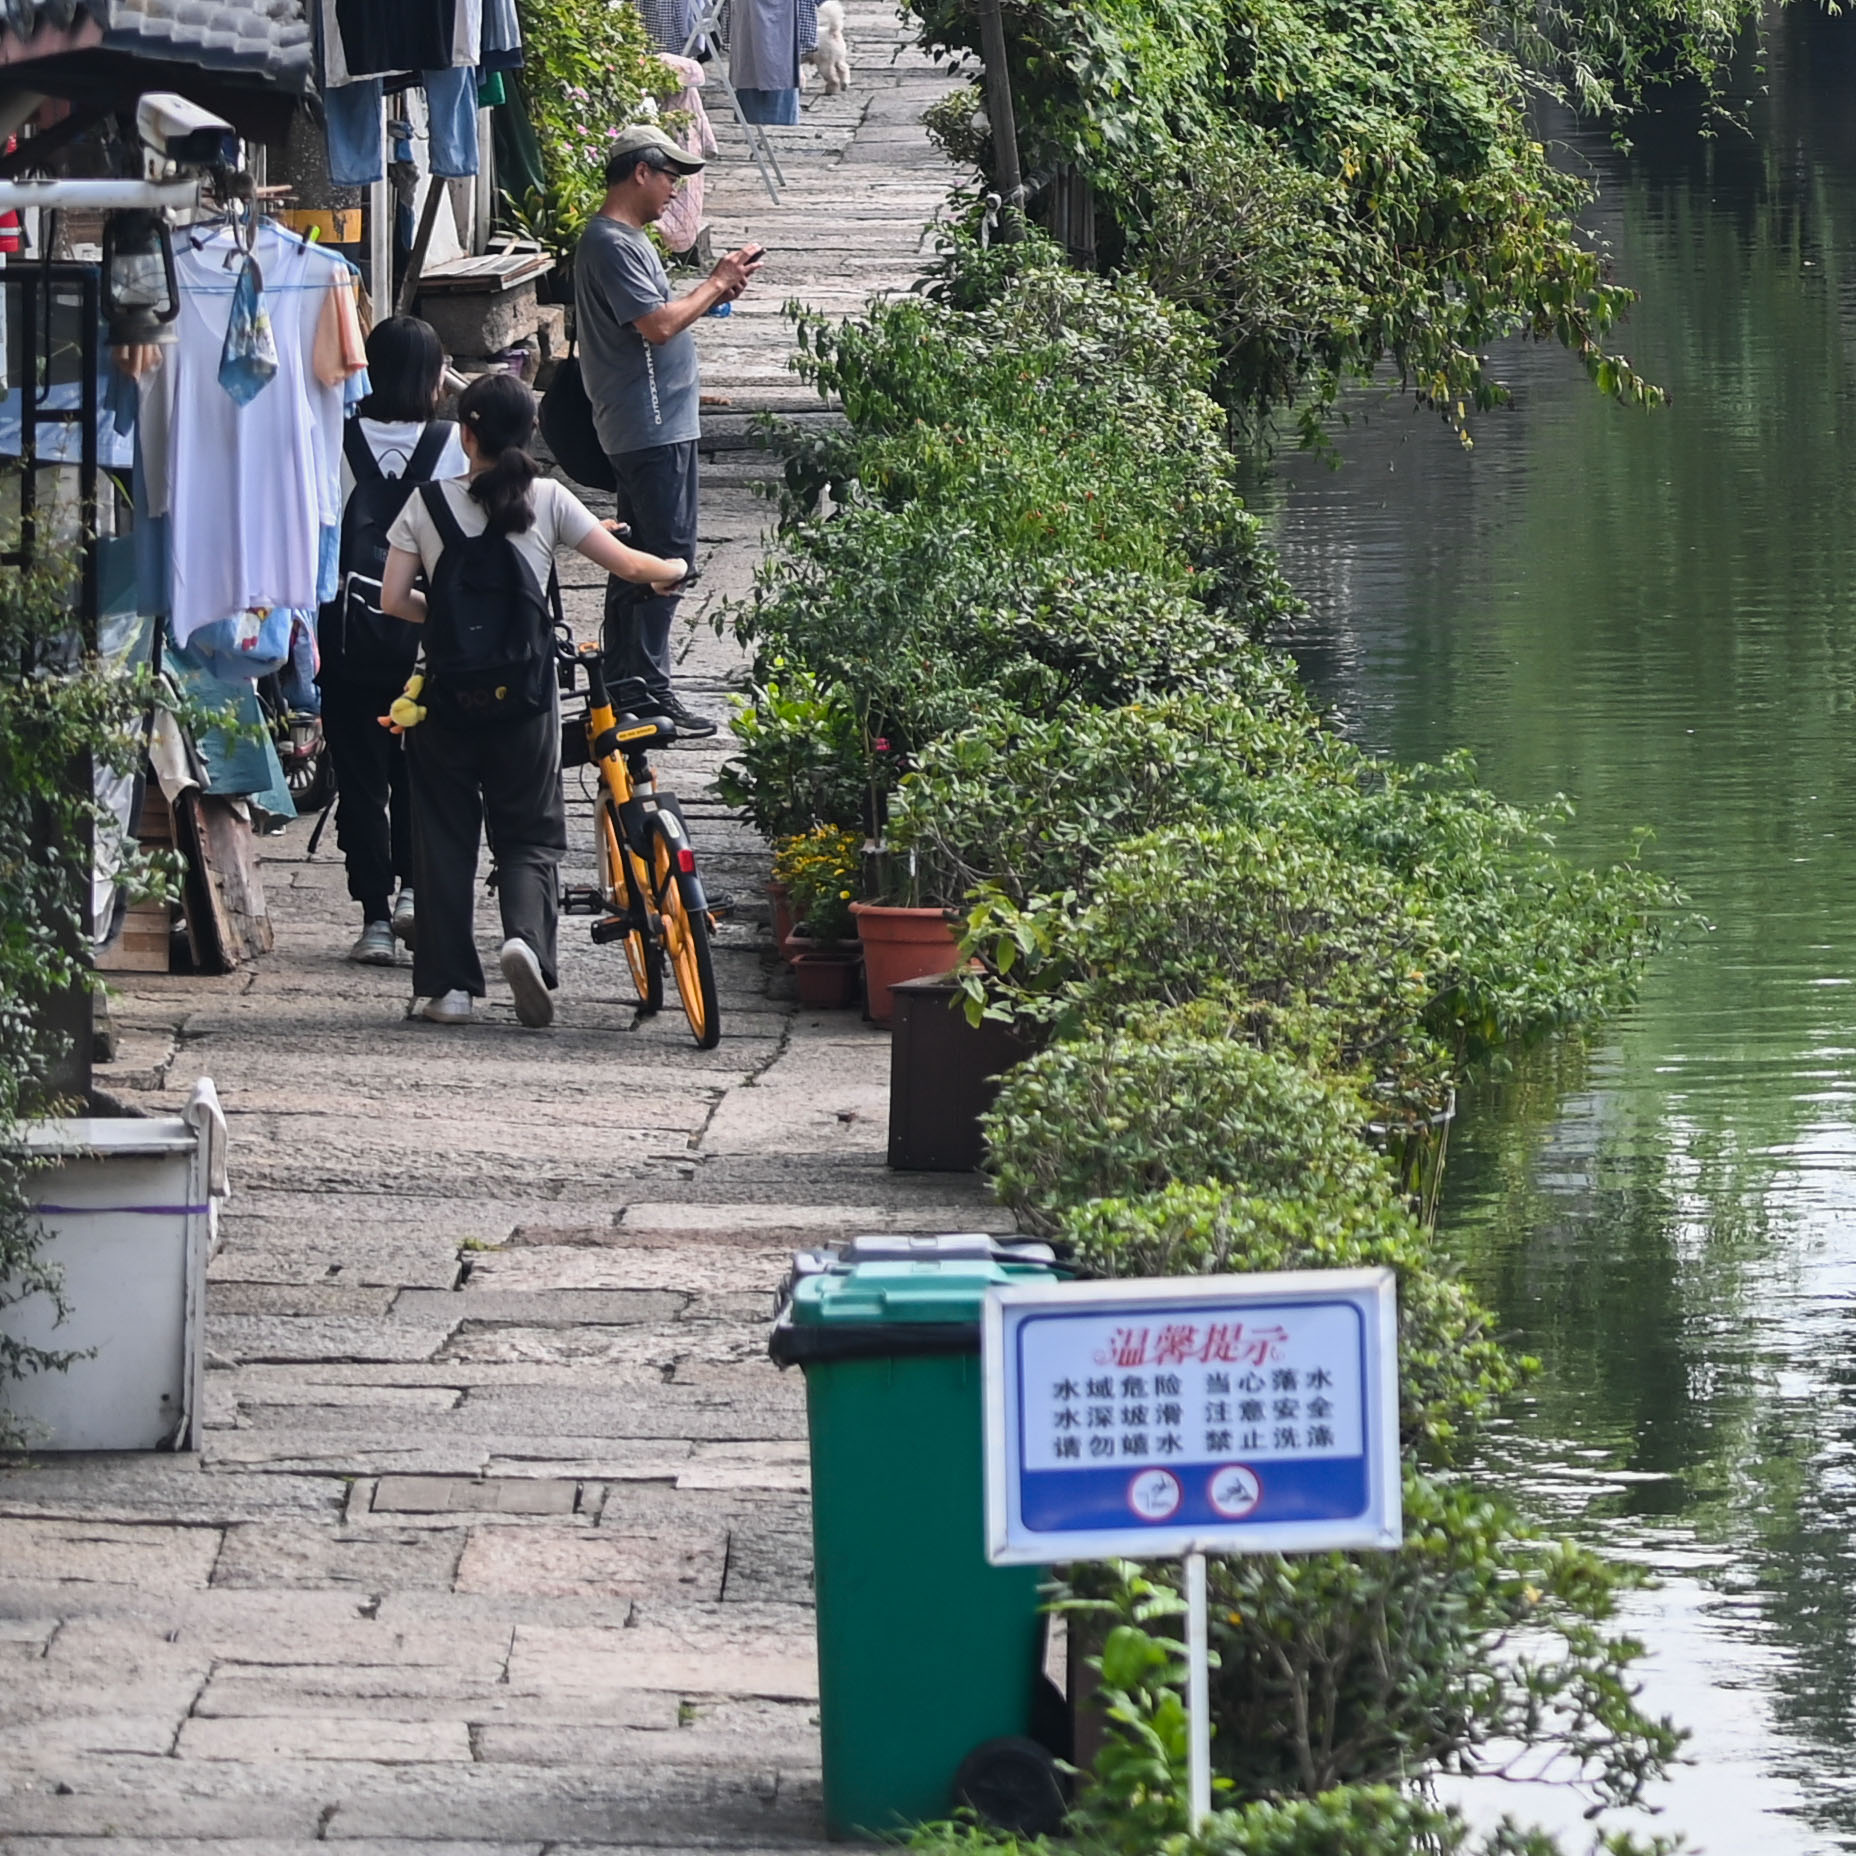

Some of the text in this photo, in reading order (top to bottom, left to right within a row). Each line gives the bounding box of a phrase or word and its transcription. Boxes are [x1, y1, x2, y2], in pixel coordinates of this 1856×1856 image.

[1111, 1324, 1288, 1366] 温馨提示
[1053, 1367, 1333, 1401] 水域危险 当心落水
[1054, 1395, 1335, 1431] 水深坡滑 注意安全
[1054, 1424, 1336, 1459] 请勿嬉水 禁止洗涤
